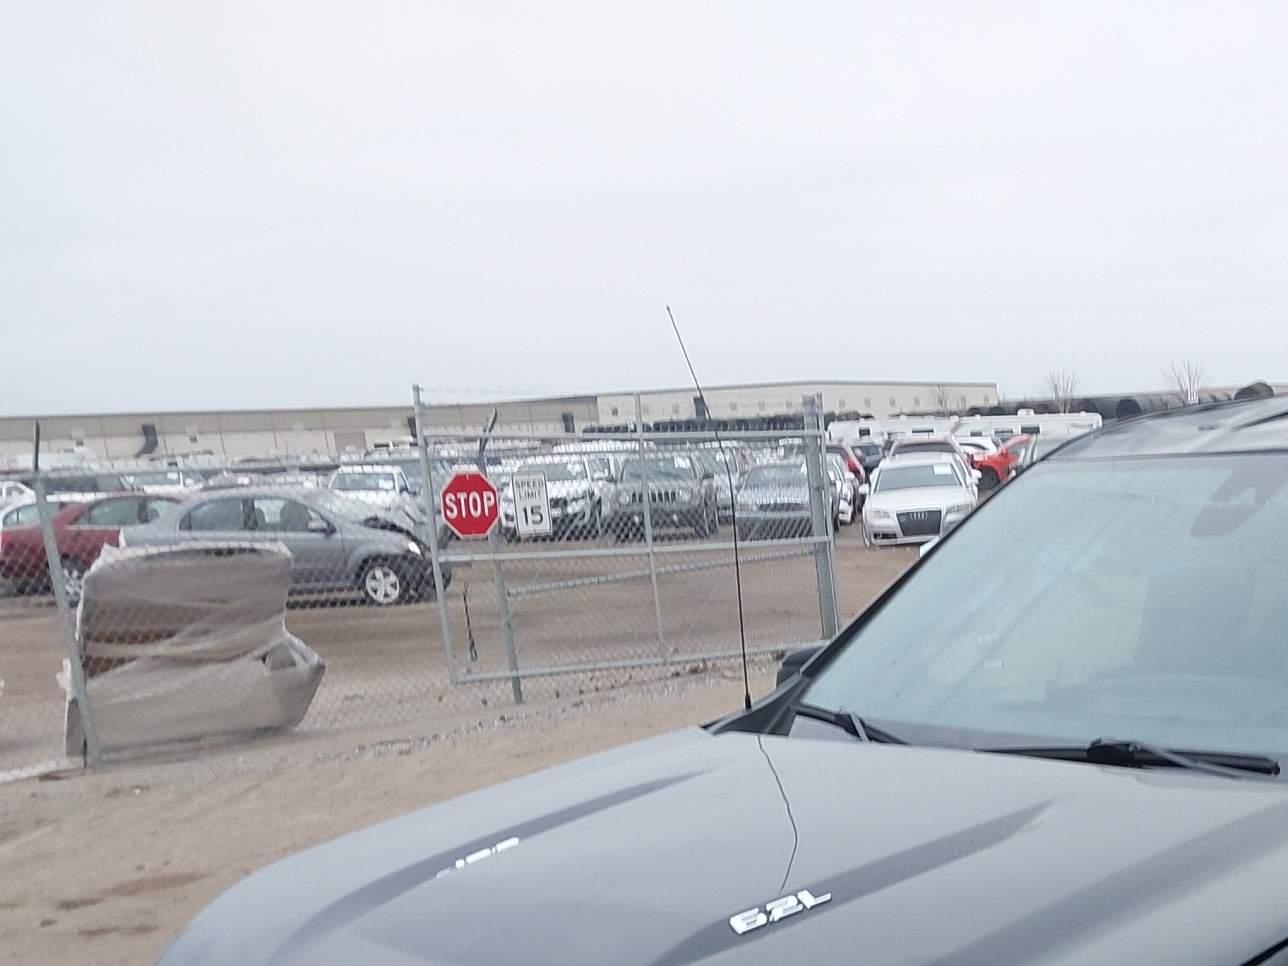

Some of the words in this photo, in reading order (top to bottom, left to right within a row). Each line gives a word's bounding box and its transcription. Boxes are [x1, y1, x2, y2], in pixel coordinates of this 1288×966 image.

[515, 480, 544, 489] SPEED
[518, 490, 541, 499] LIMIT
[445, 490, 495, 520] STOP
[523, 505, 544, 525] 15
